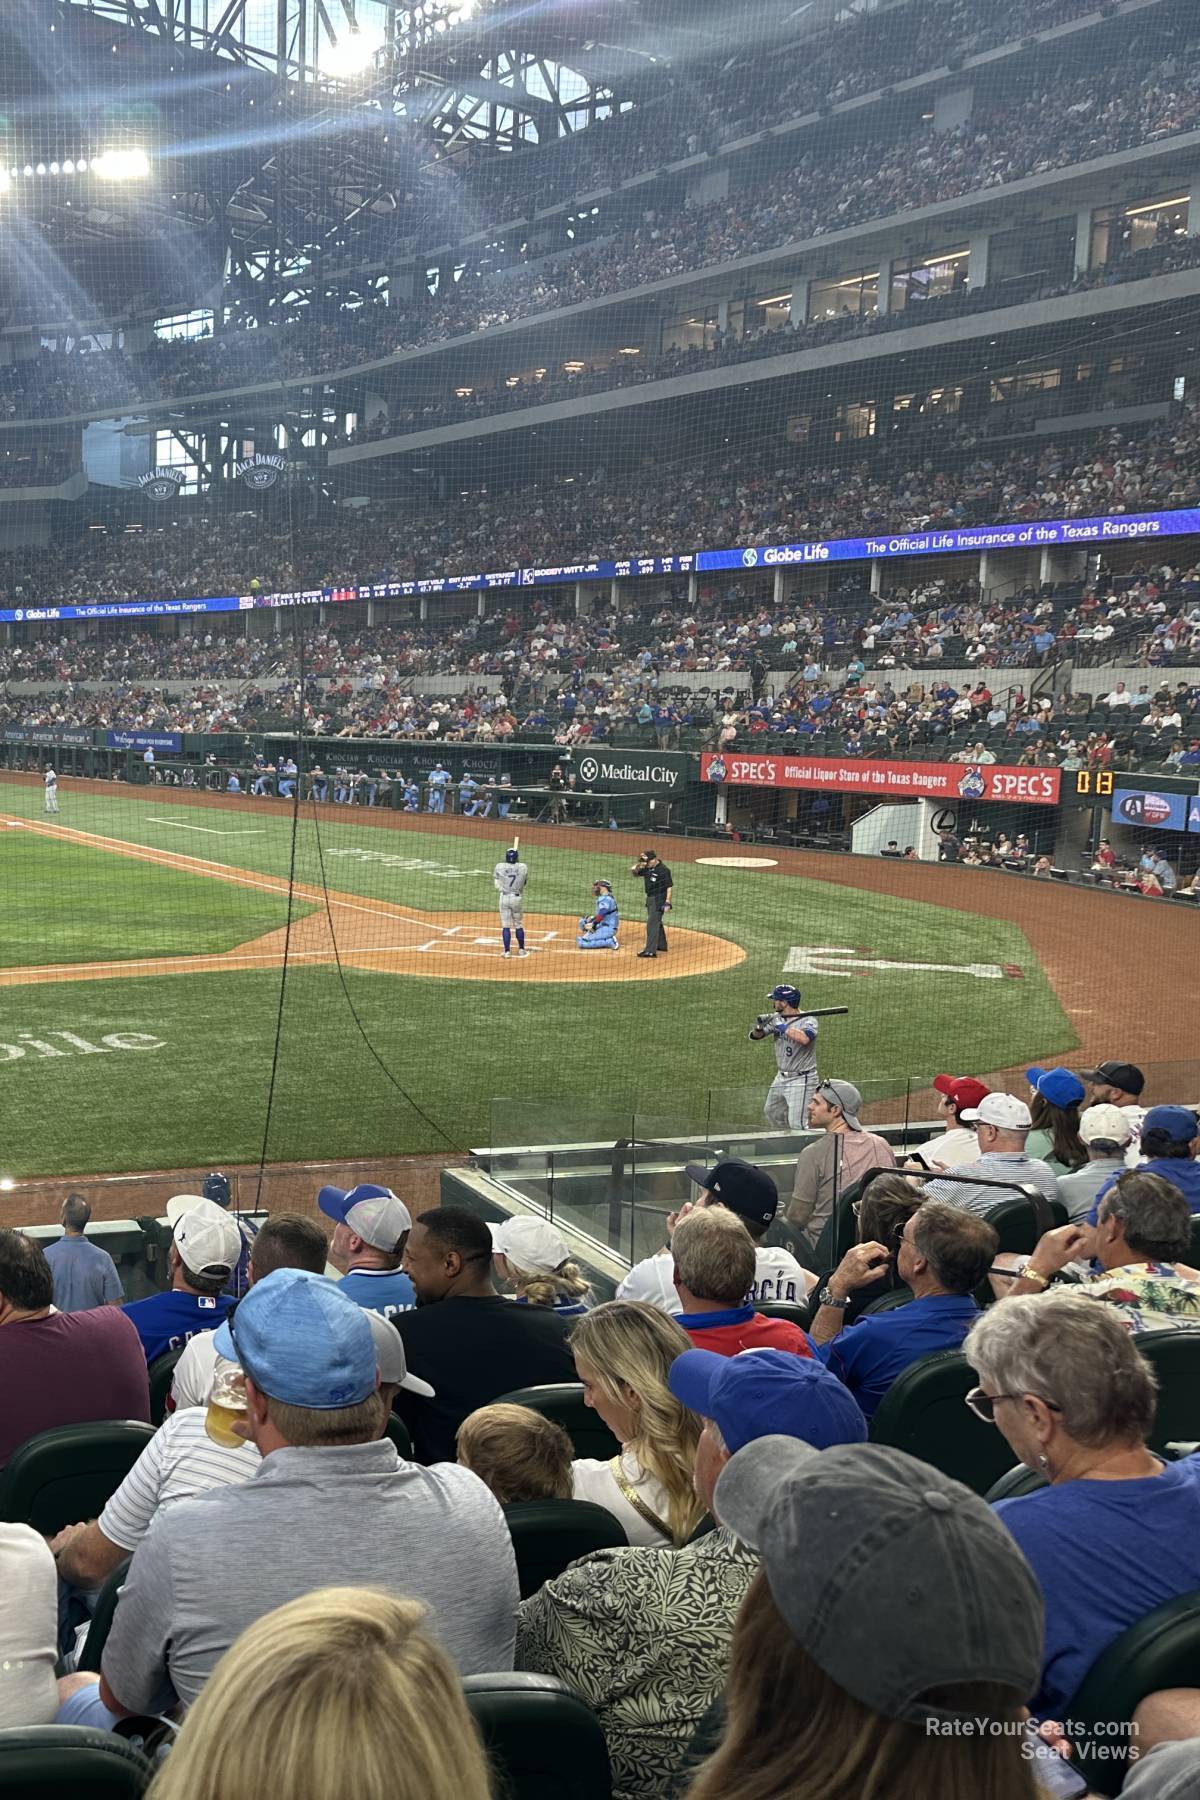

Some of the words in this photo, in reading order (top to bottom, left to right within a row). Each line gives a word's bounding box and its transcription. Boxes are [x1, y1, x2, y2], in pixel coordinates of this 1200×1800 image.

[865, 540, 886, 555] The
[888, 536, 929, 554] Official
[932, 534, 954, 550] Life
[956, 529, 1016, 548] Insurance
[1018, 526, 1034, 541] of
[1035, 524, 1058, 541] the
[1060, 521, 1099, 539] Texas
[1101, 518, 1160, 538] Rangers
[763, 546, 802, 564] Globe
[803, 544, 829, 561] Life
[563, 564, 585, 575] WITT
[462, 758, 499, 769] CHOCTA
[731, 760, 777, 781] SPEC'S
[600, 764, 650, 782] Medical
[651, 766, 679, 788] City
[784, 766, 812, 780] Official
[813, 767, 837, 782] Liquor
[839, 769, 860, 782] Store
[861, 770, 870, 783] of
[872, 770, 886, 783] the
[887, 772, 911, 785] Texas
[912, 773, 947, 789] Rangers
[992, 773, 1053, 797] SPEC'S
[508, 875, 517, 888] 7
[786, 1046, 793, 1057] 9
